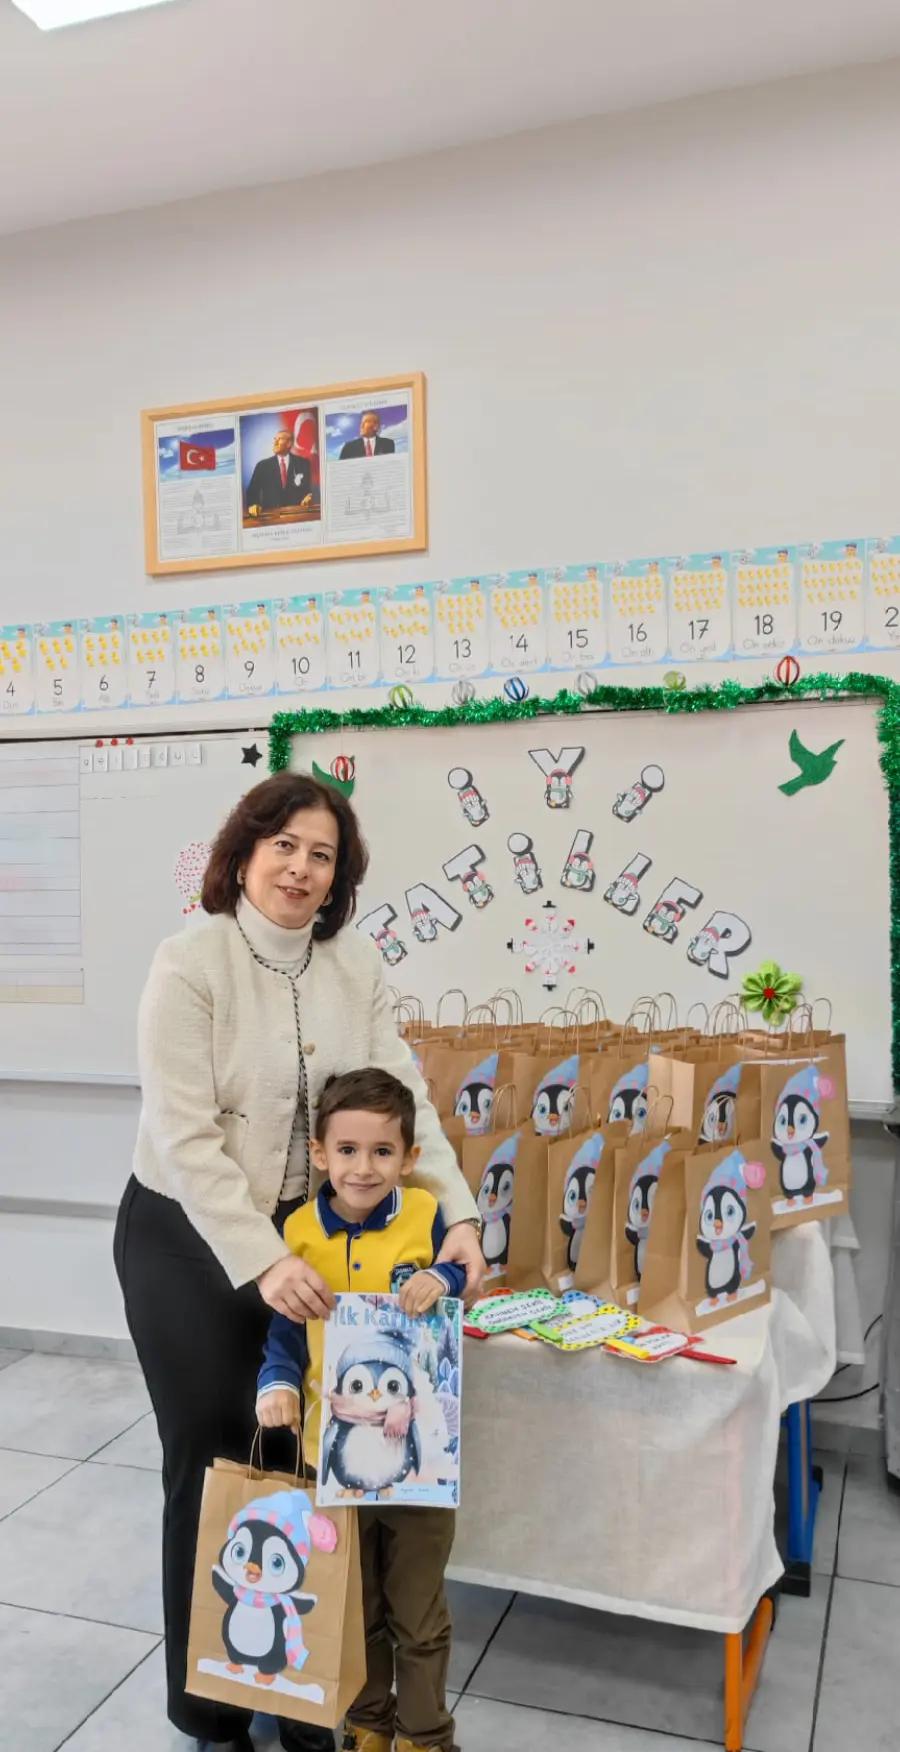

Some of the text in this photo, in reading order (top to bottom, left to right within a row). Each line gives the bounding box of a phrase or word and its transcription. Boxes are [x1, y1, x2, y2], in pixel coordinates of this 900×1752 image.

[754, 613, 774, 636] 18
[821, 610, 843, 632] 19
[885, 606, 900, 628] 2
[567, 628, 589, 649] 15
[627, 622, 648, 643] 16
[688, 618, 710, 641] 17
[453, 638, 472, 659] 13
[509, 633, 528, 653] 14
[347, 650, 361, 669] 11
[397, 644, 416, 664] 12
[194, 664, 205, 683] 8
[244, 660, 255, 678] 9
[291, 656, 310, 675] 10
[6, 681, 16, 697] 4
[53, 679, 63, 696] 5
[99, 674, 109, 691] 6
[146, 670, 156, 688] 7
[356, 829, 752, 980] TATİLLER
